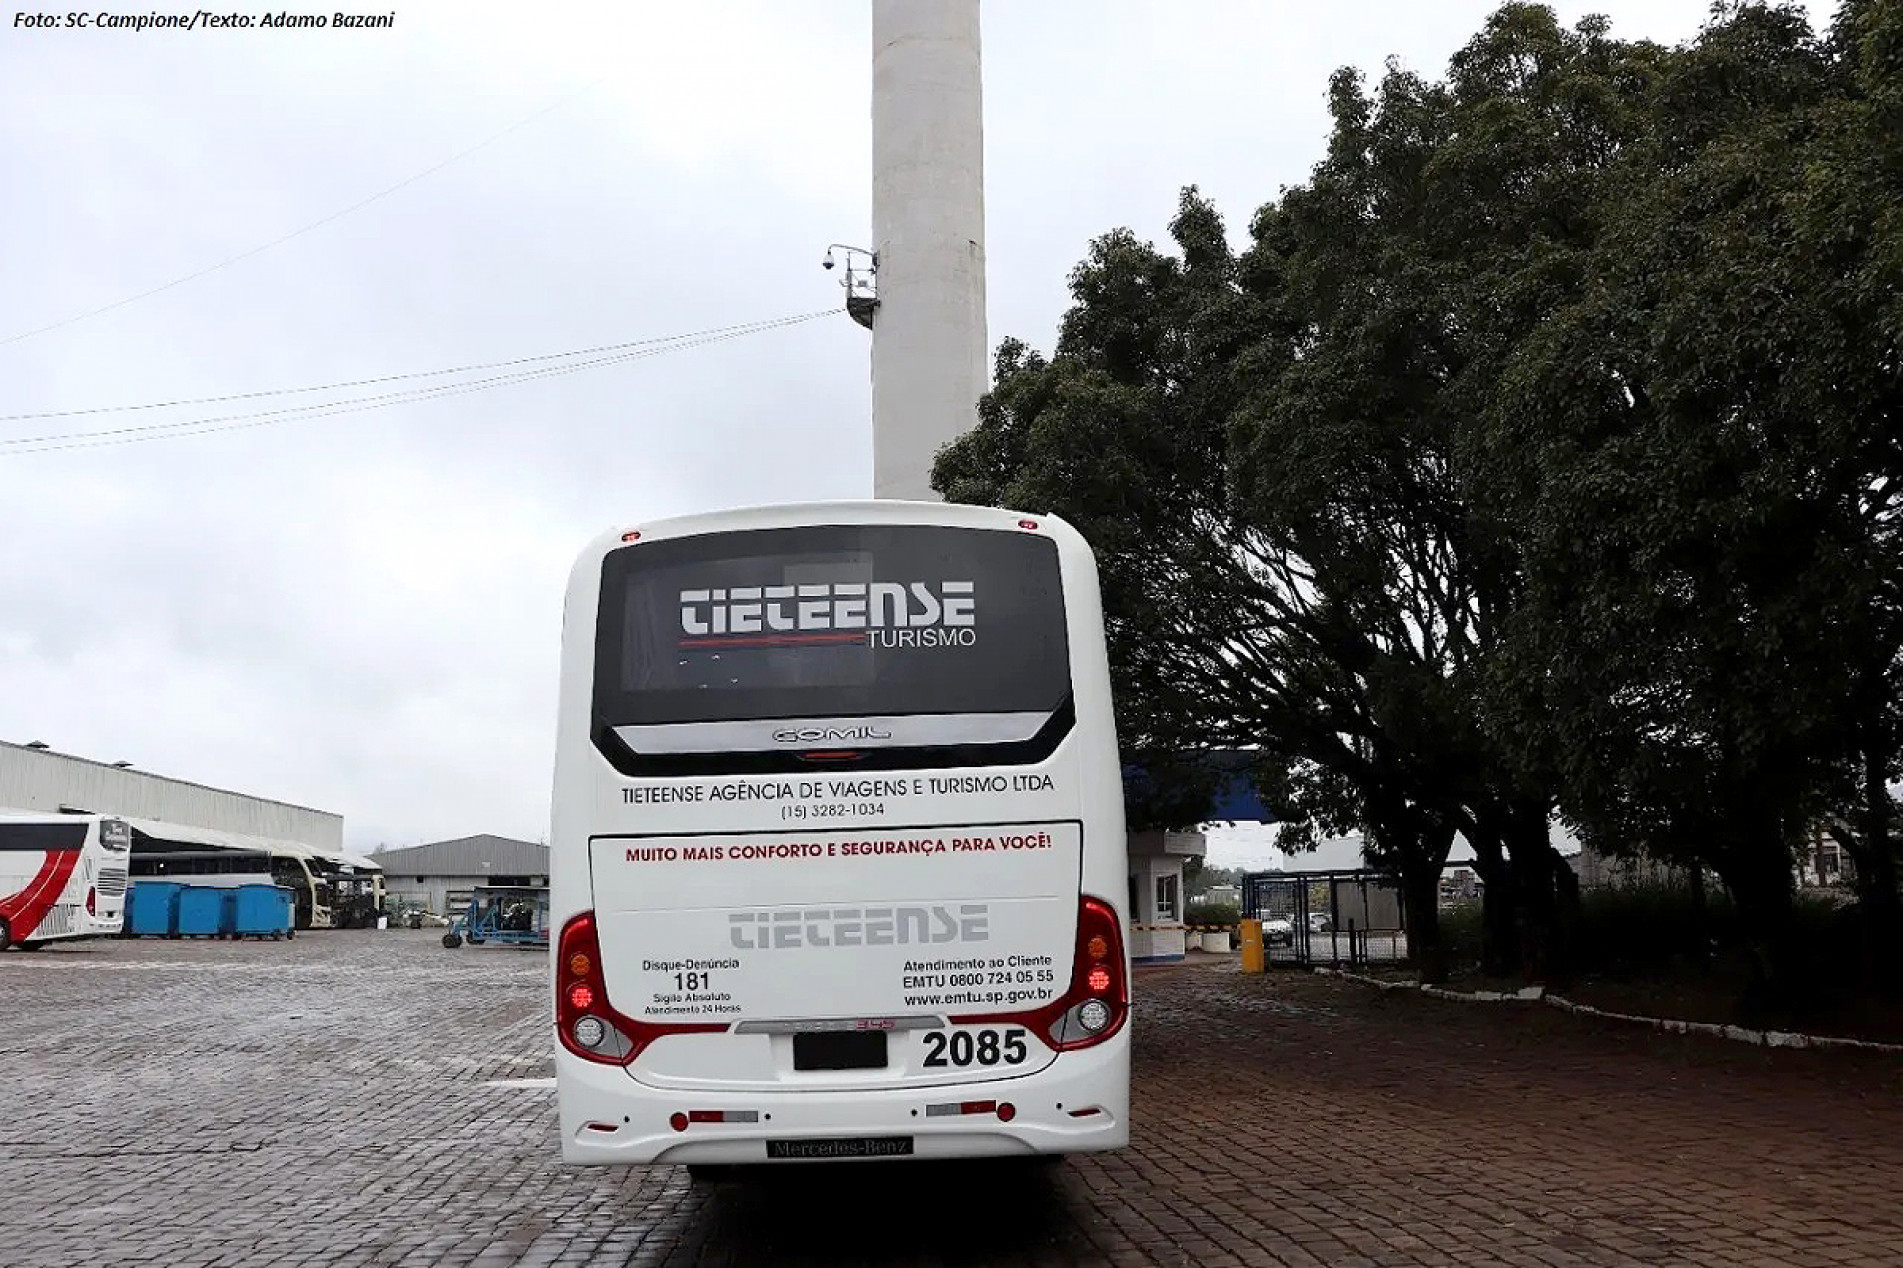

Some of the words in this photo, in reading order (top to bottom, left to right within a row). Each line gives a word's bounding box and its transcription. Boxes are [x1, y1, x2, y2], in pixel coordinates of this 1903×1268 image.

[866, 629, 975, 648] TURISMO
[772, 726, 892, 742] COMIL
[622, 786, 703, 803] TIETEENSE
[709, 780, 793, 800] AGÊNCIA
[801, 783, 822, 797] DE
[829, 780, 907, 797] VIAGENS
[914, 780, 922, 794] E
[929, 776, 1007, 794] TURISMO
[1013, 775, 1053, 791] LTDA
[782, 805, 806, 820] (15)
[812, 803, 884, 816] 3282-1034
[627, 848, 677, 861] MUITO
[684, 848, 723, 859] MAIS
[729, 845, 822, 859] CONFORTO
[828, 843, 835, 856] E
[842, 840, 945, 856] SEGURANÇA
[953, 838, 995, 851] PARA
[1000, 832, 1051, 849] VOCÊ!
[643, 959, 739, 973] Disque-Denúncia
[904, 959, 985, 971] Atendimento
[989, 959, 1004, 968] ao
[1008, 956, 1051, 967] Cliente
[674, 972, 708, 991] 181
[904, 975, 945, 988] EMTU
[950, 974, 983, 986] 0800
[988, 972, 1012, 984] 724
[1017, 971, 1033, 983] 05
[1037, 970, 1053, 981] 55
[904, 988, 1053, 1006] www.emtu.sp.gov.br
[922, 1030, 1027, 1067] 2085
[774, 1139, 908, 1156] Mercedes-Benz
